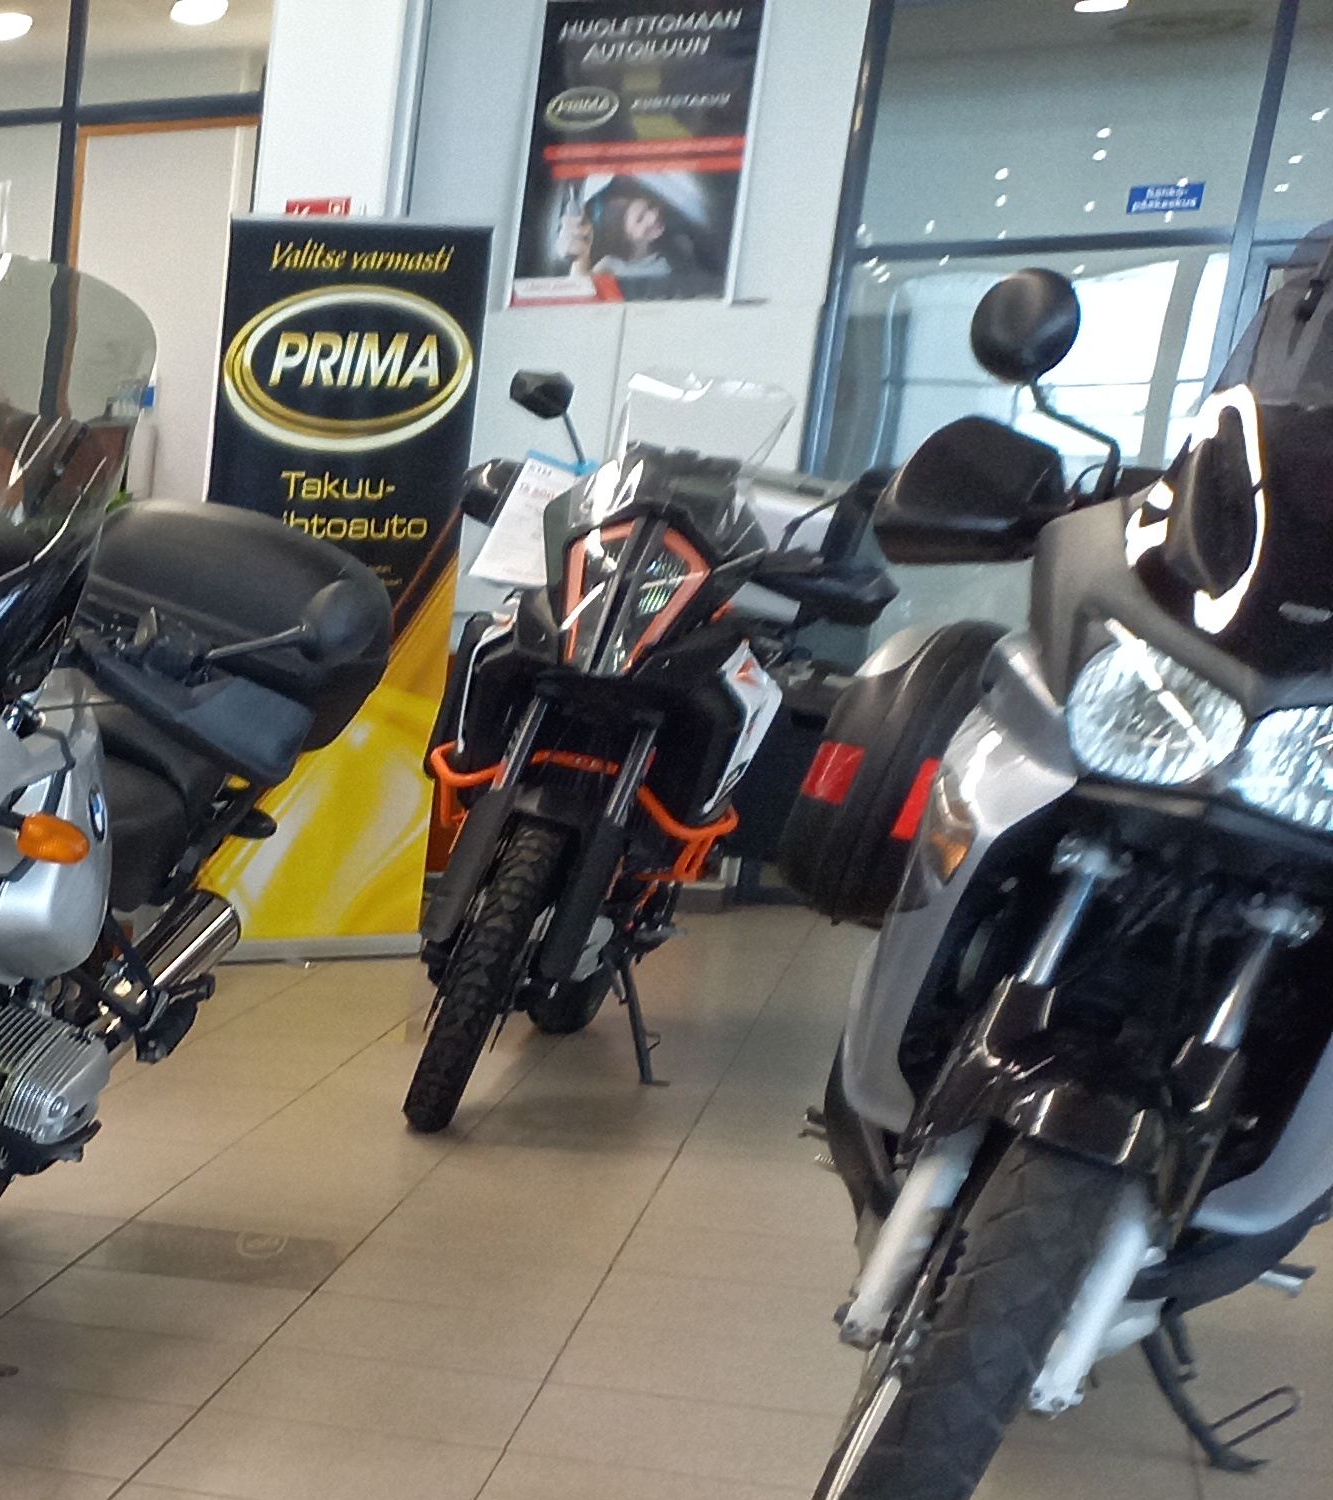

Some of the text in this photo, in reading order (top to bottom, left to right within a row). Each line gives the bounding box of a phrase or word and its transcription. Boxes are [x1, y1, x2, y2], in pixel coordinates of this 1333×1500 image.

[269, 238, 454, 274] Valitse varmasti
[268, 331, 440, 389] PRIMA
[281, 470, 395, 501] Takuu-
